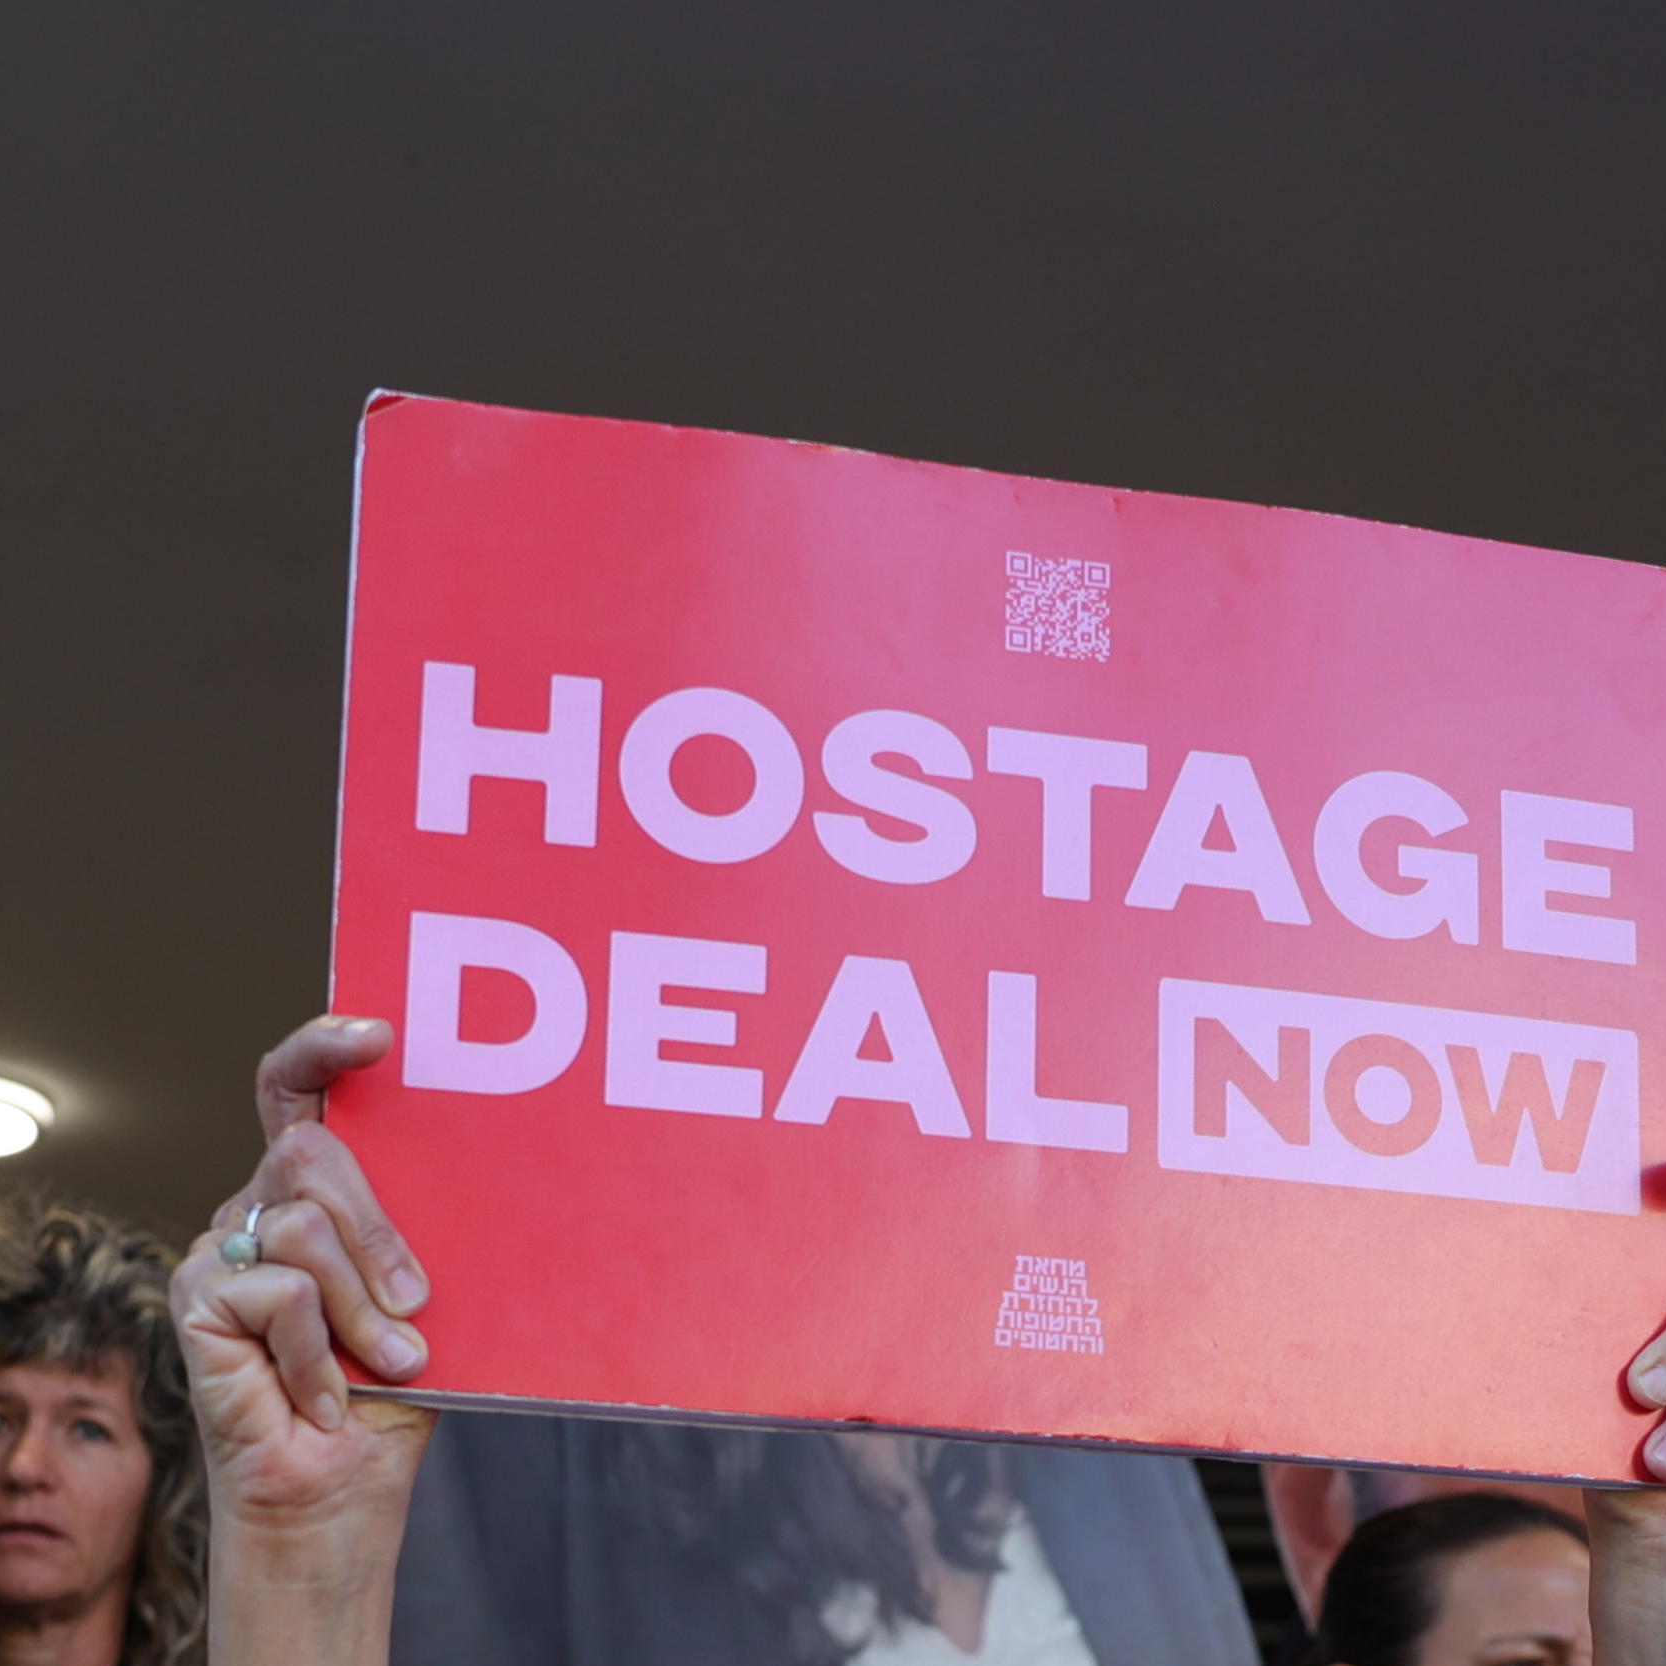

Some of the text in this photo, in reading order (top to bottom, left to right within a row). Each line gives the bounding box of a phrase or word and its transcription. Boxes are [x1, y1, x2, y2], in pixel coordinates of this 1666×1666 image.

[416, 660, 1637, 964] HOSTAGE
[402, 911, 1608, 1176] DEAL NOW
[1015, 1254, 1086, 1278] מחאת
[1013, 1273, 1087, 1297] הנשים
[1001, 1291, 1099, 1316] להחזרת
[997, 1309, 1102, 1336] החטופות
[994, 1328, 1104, 1354] והחטופים
